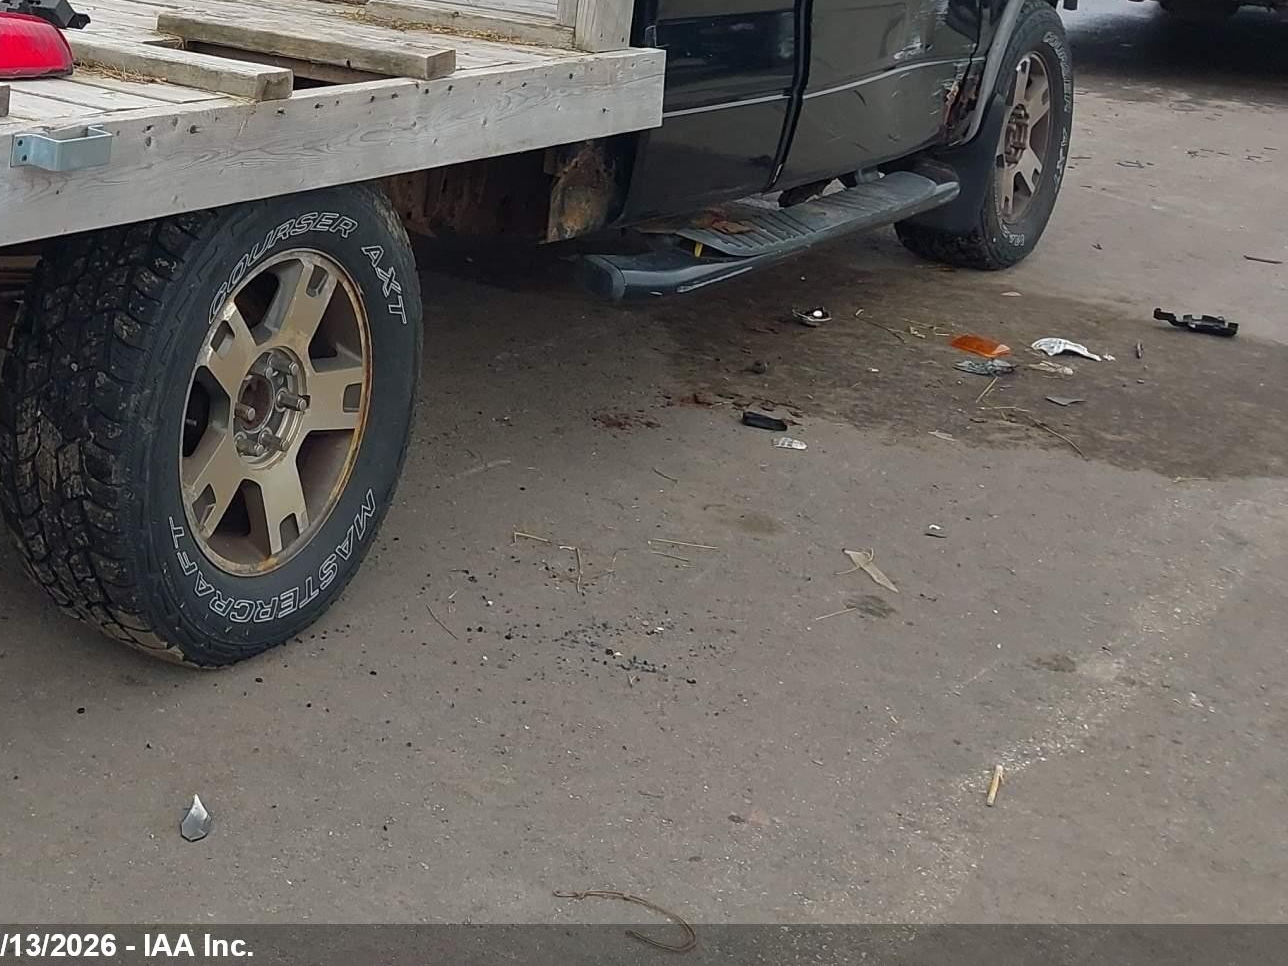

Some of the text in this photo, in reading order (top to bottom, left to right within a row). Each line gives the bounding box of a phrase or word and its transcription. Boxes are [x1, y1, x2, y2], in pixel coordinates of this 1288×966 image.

[208, 212, 408, 325] COURSER AXT
[167, 487, 377, 624] MASTERCRAFT
